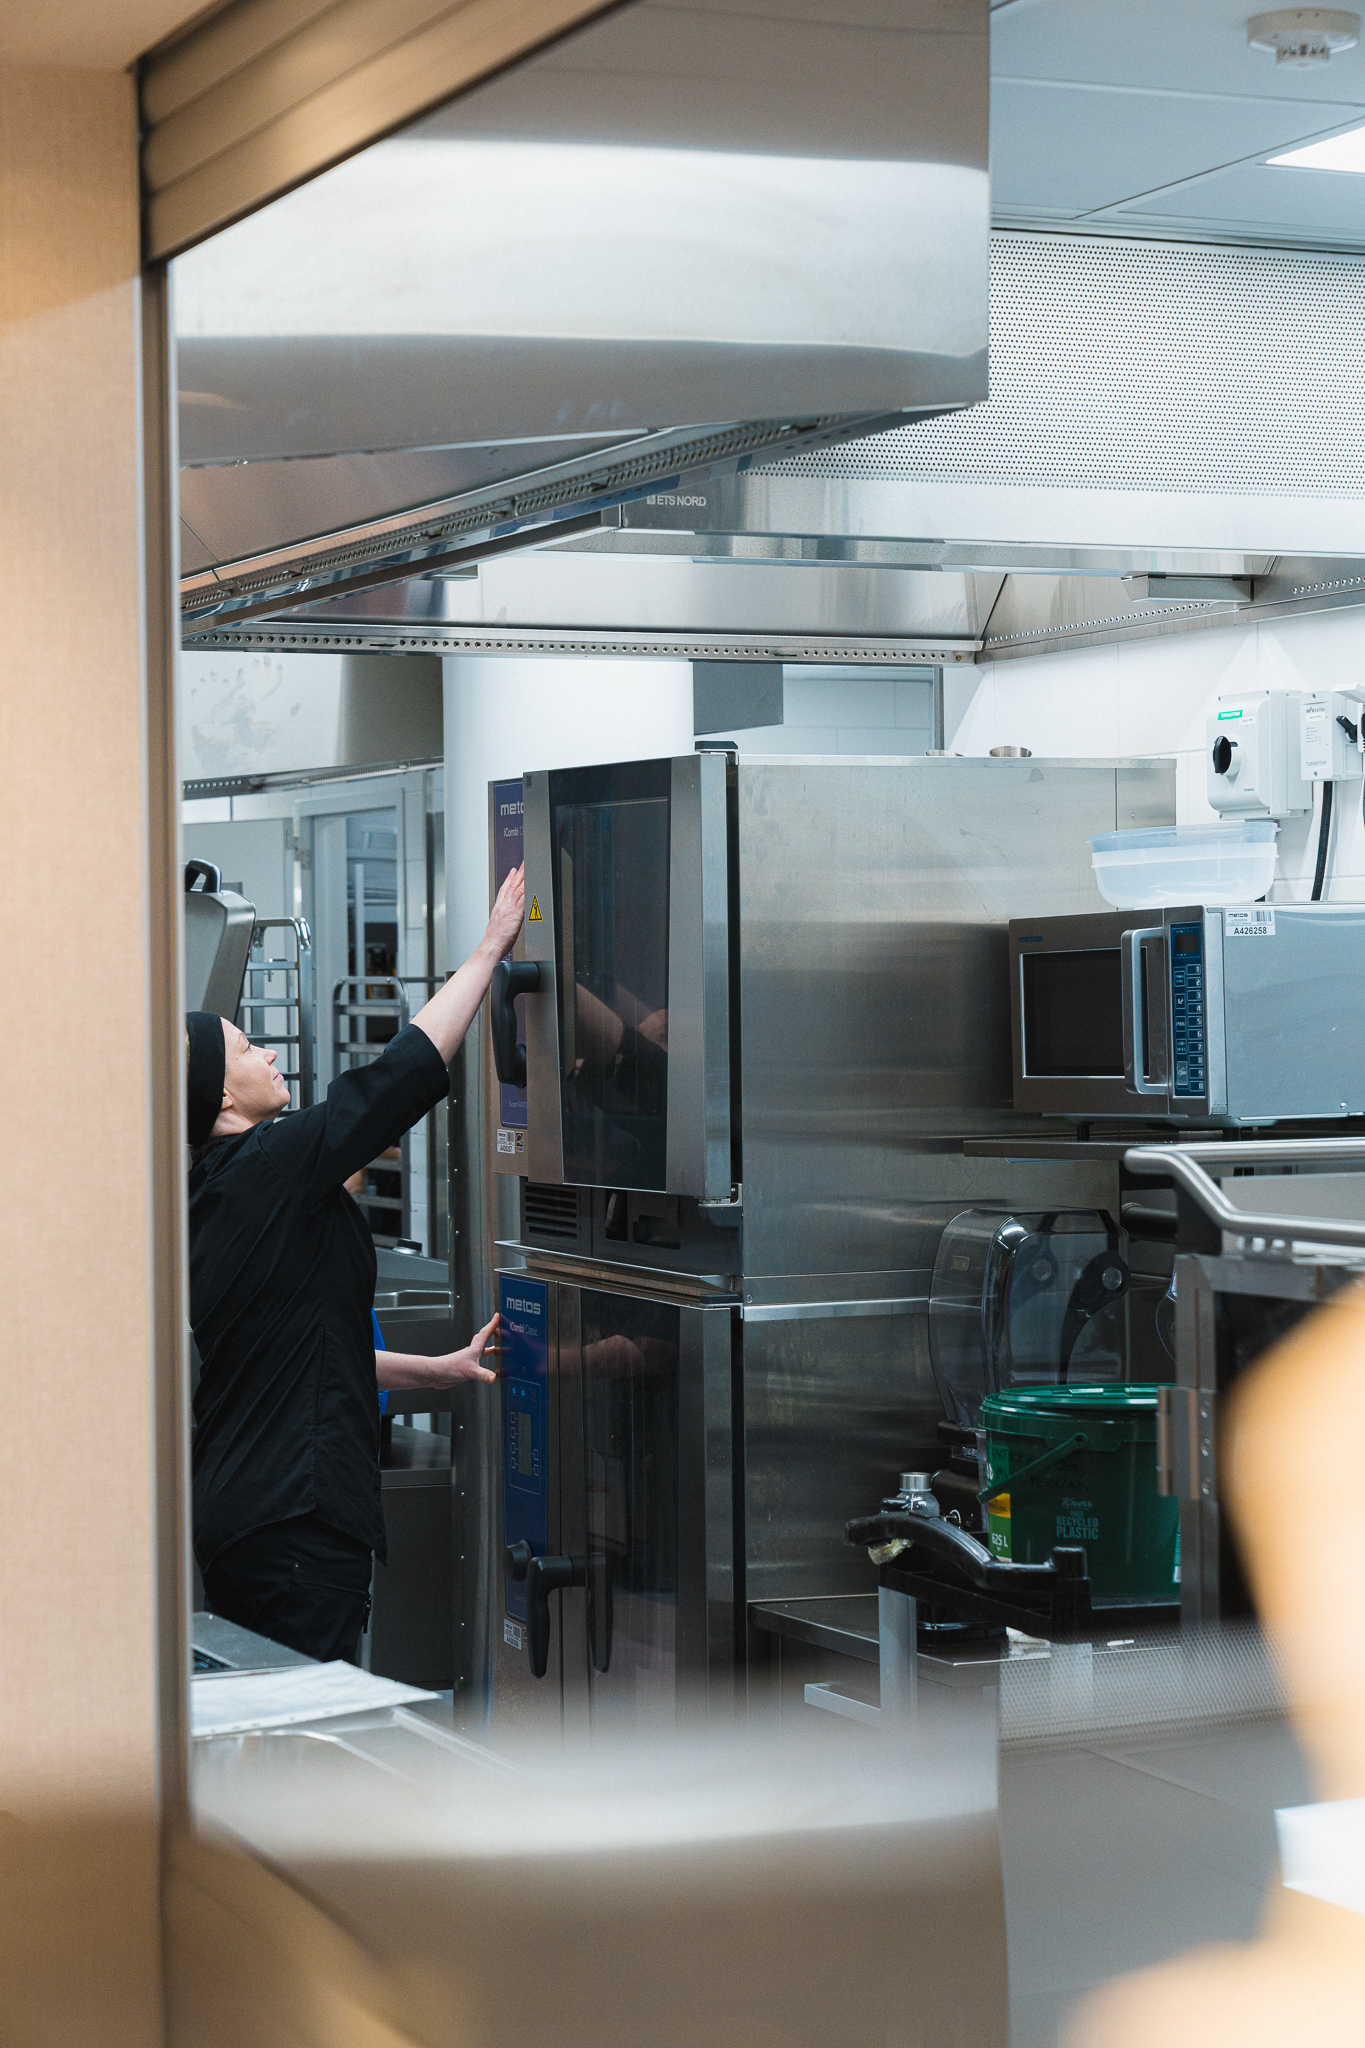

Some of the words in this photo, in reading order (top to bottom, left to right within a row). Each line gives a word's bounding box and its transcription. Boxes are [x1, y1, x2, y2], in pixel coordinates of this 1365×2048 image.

[657, 495, 676, 506] ETS
[677, 496, 706, 506] NORD
[500, 801, 524, 816] met
[1234, 926, 1267, 934] A426258
[506, 1296, 540, 1315] metos
[510, 1321, 524, 1333] iCombi
[1062, 1497, 1092, 1507] Knorr
[1056, 1516, 1098, 1527] RECYCLED
[1056, 1526, 1098, 1539] PLASTIC
[1004, 1535, 1008, 1547] L
